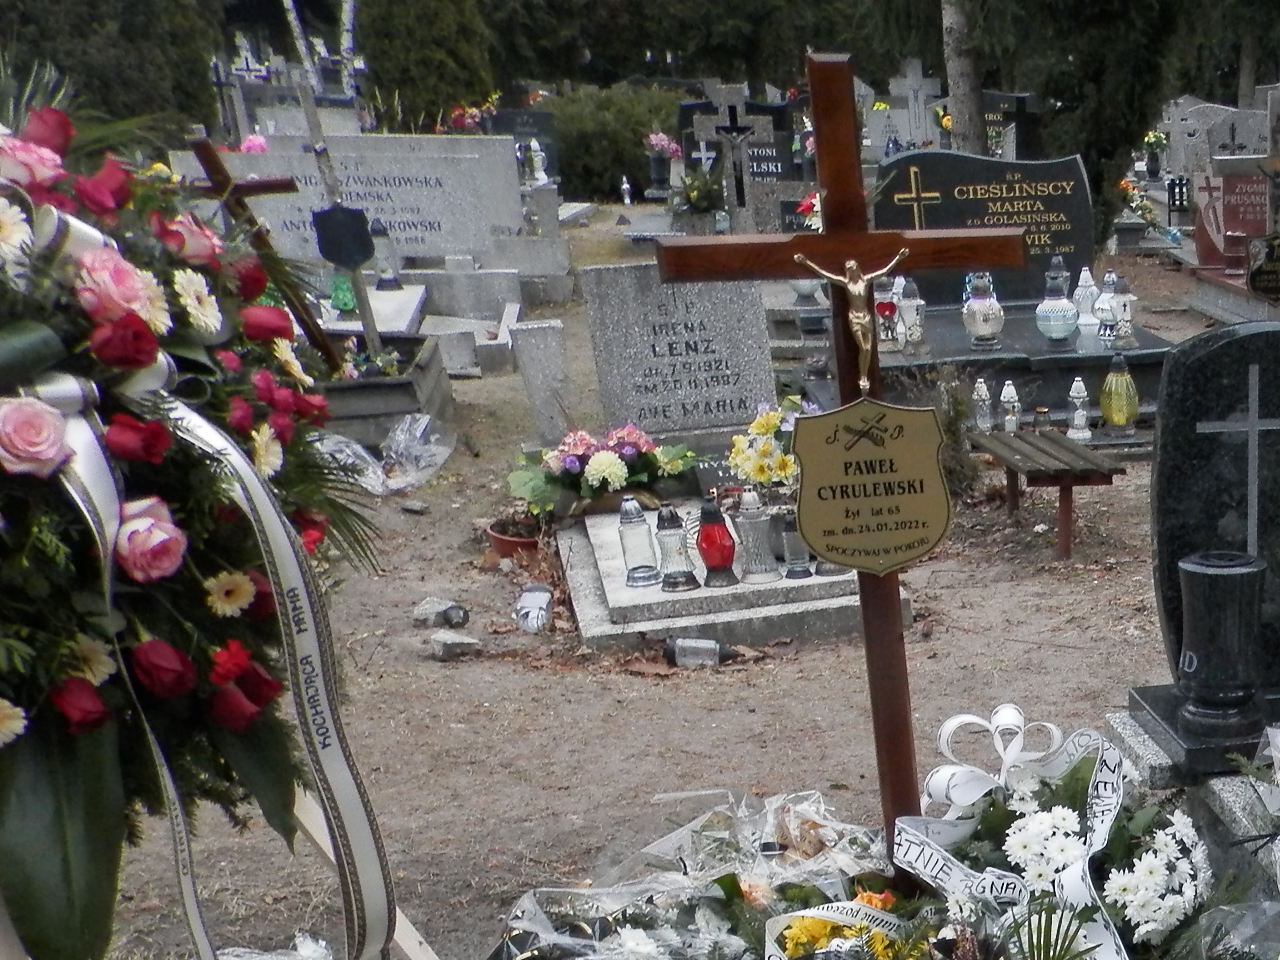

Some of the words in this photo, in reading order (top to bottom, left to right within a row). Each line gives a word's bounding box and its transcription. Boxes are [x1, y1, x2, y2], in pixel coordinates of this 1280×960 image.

[987, 201, 1044, 213] MARTA
[652, 319, 706, 337] IRENA
[651, 339, 716, 359] LENZ
[843, 459, 899, 477] PAWEŁ
[817, 479, 926, 502] CYRULEWSKI
[871, 505, 884, 518] lat
